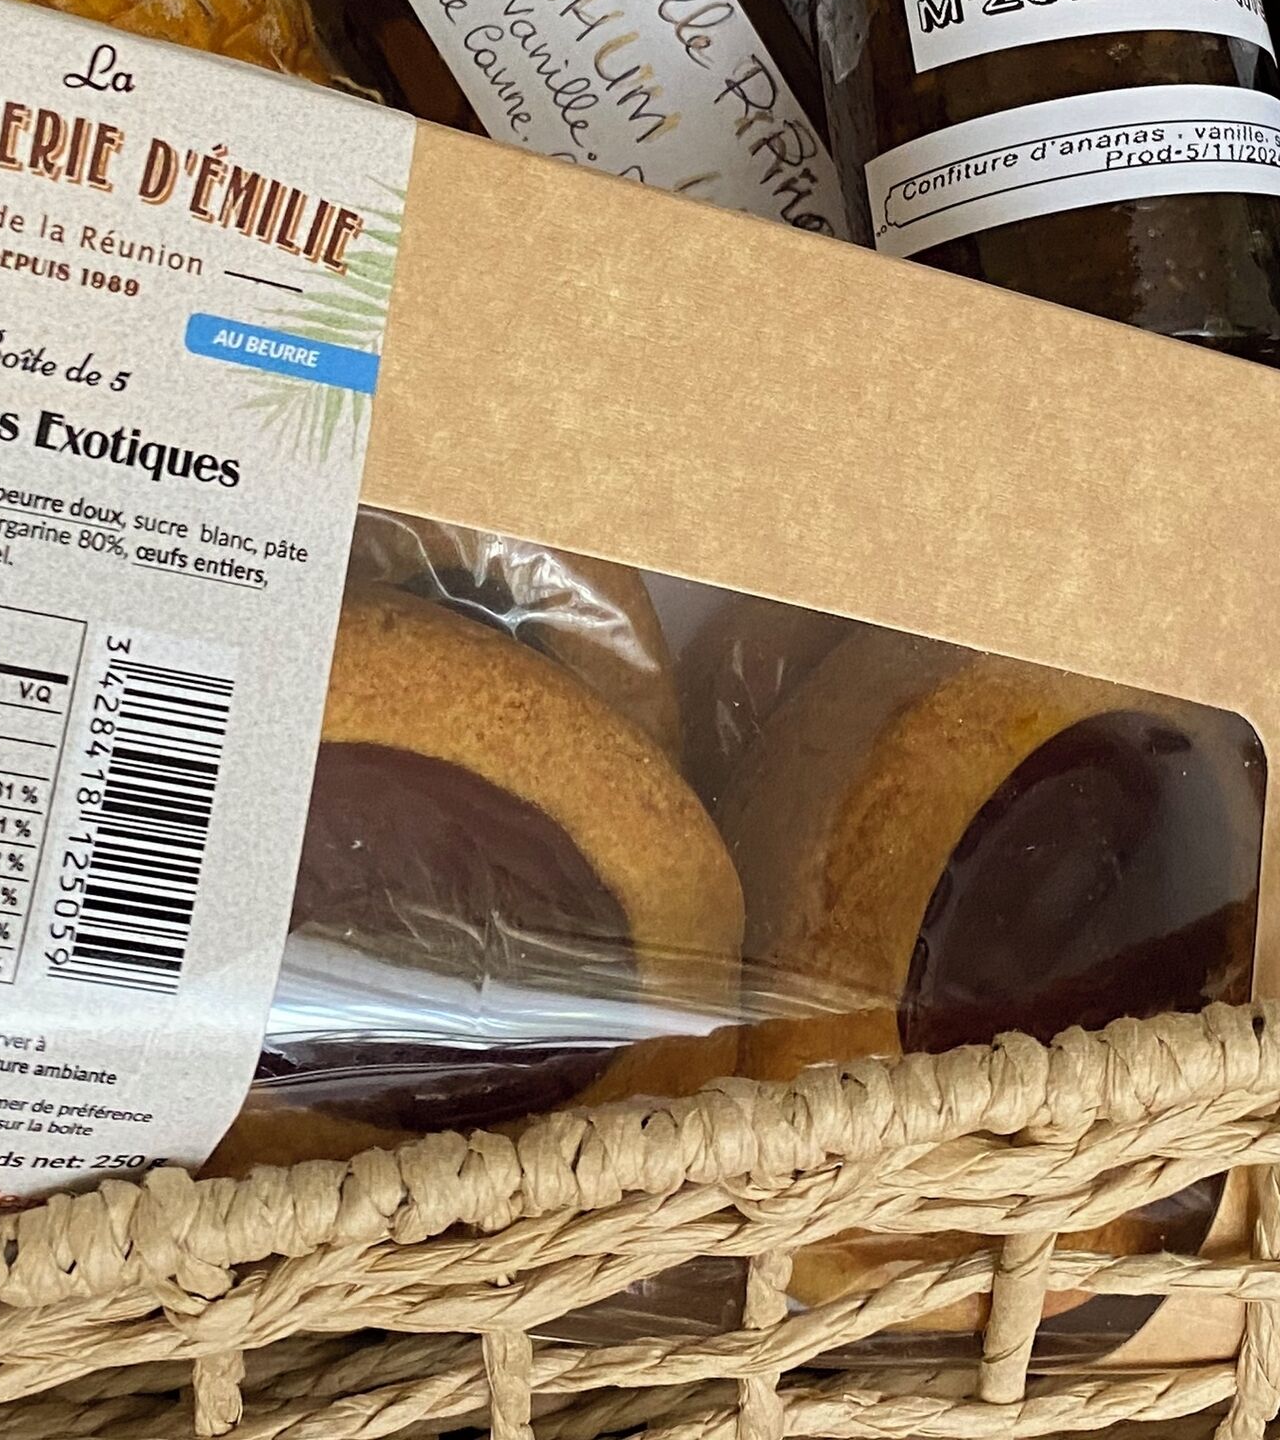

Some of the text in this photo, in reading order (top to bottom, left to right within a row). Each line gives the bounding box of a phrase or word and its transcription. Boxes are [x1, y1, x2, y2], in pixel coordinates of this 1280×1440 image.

[63, 45, 134, 92] La
[902, 153, 1019, 200] Confiture
[1030, 128, 1165, 161] d'ananas
[139, 138, 363, 276] D'ÉMILIE
[41, 215, 64, 243] la
[81, 226, 203, 275] Réunion
[81, 269, 140, 296] 1989
[213, 330, 319, 368] AU BEURRE
[66, 354, 101, 387] de
[110, 371, 132, 392] 5
[34, 410, 240, 488] Exotiques
[70, 499, 126, 530] doux,
[134, 513, 188, 538] sucre
[200, 524, 257, 555] blanc,
[264, 538, 308, 563] pâte
[78, 529, 129, 559] 80%,
[136, 545, 188, 568] œufs
[194, 556, 269, 587] entiers,
[107, 636, 131, 655] 3
[20, 681, 51, 704] V.Q
[36, 1036, 46, 1052] à
[33, 1064, 117, 1085] ambiante
[27, 1119, 42, 1133] la
[32, 1099, 54, 1114] de
[57, 1102, 153, 1123] préférence
[90, 1154, 145, 1169] 250
